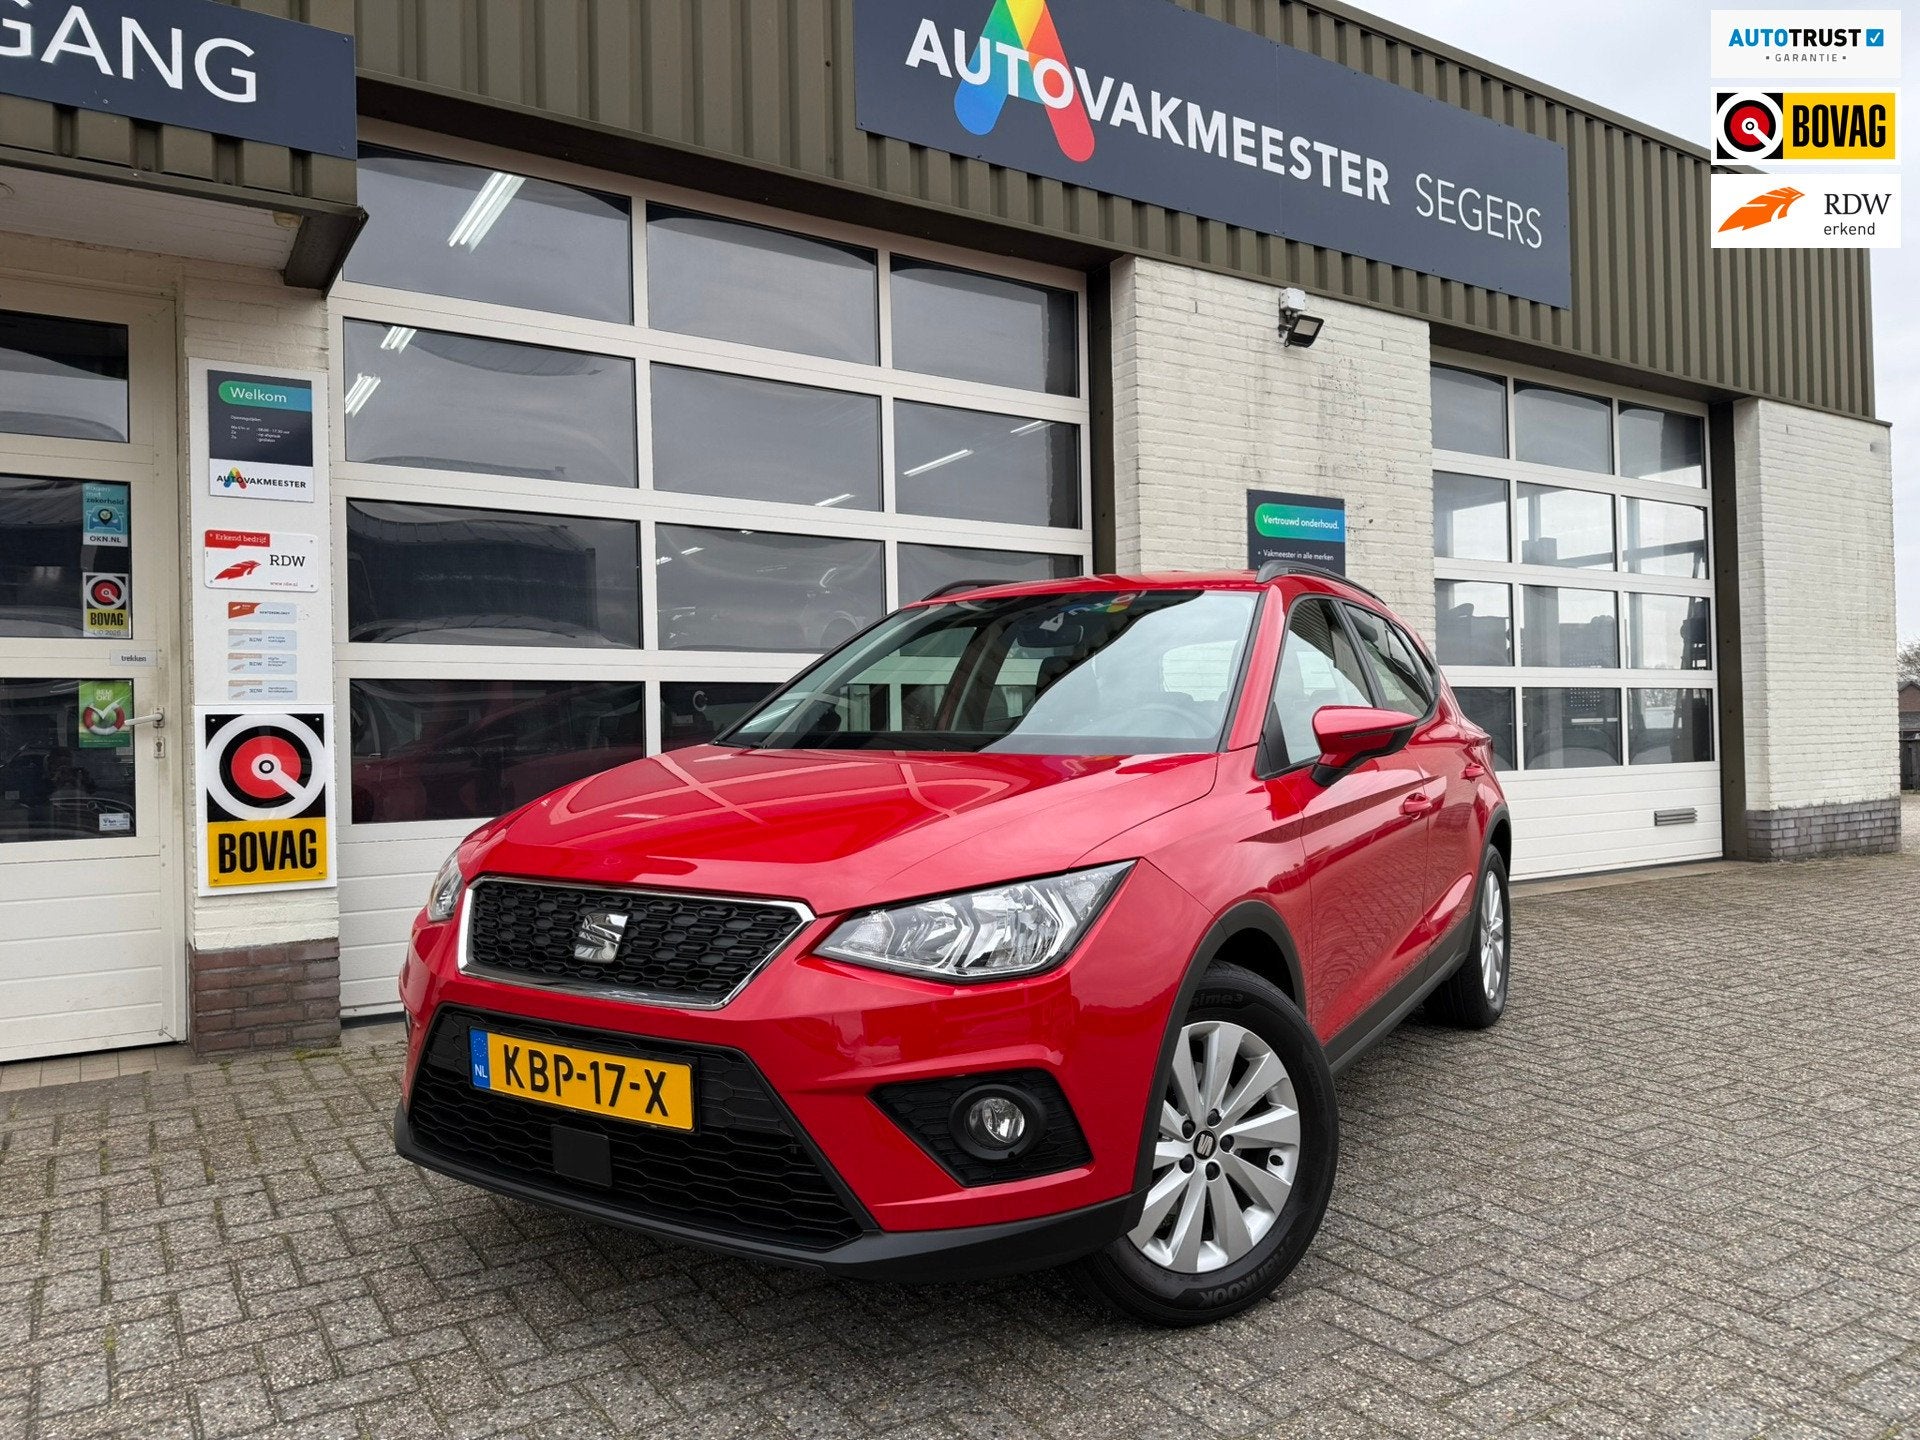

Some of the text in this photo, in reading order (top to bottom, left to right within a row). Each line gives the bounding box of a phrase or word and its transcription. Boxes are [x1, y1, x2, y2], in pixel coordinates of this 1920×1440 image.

[905, 18, 1543, 250] AUTOVAKMEESTER SEGERS
[230, 386, 287, 403] Welkom
[216, 474, 307, 489] AUTOVAKMEESTER
[1263, 515, 1340, 530] Vertrouwd onderhoud.
[89, 535, 122, 544] OKN.NL
[215, 533, 267, 544] Erkend bedrijf
[269, 554, 306, 567] RDW
[1263, 549, 1334, 561] Vakmeester in alle merken
[90, 611, 124, 627] BOVAG
[121, 654, 147, 662] trekken
[218, 828, 317, 874] BOVAG
[474, 1063, 488, 1079] NL
[503, 1043, 669, 1117] KBP-17-X
